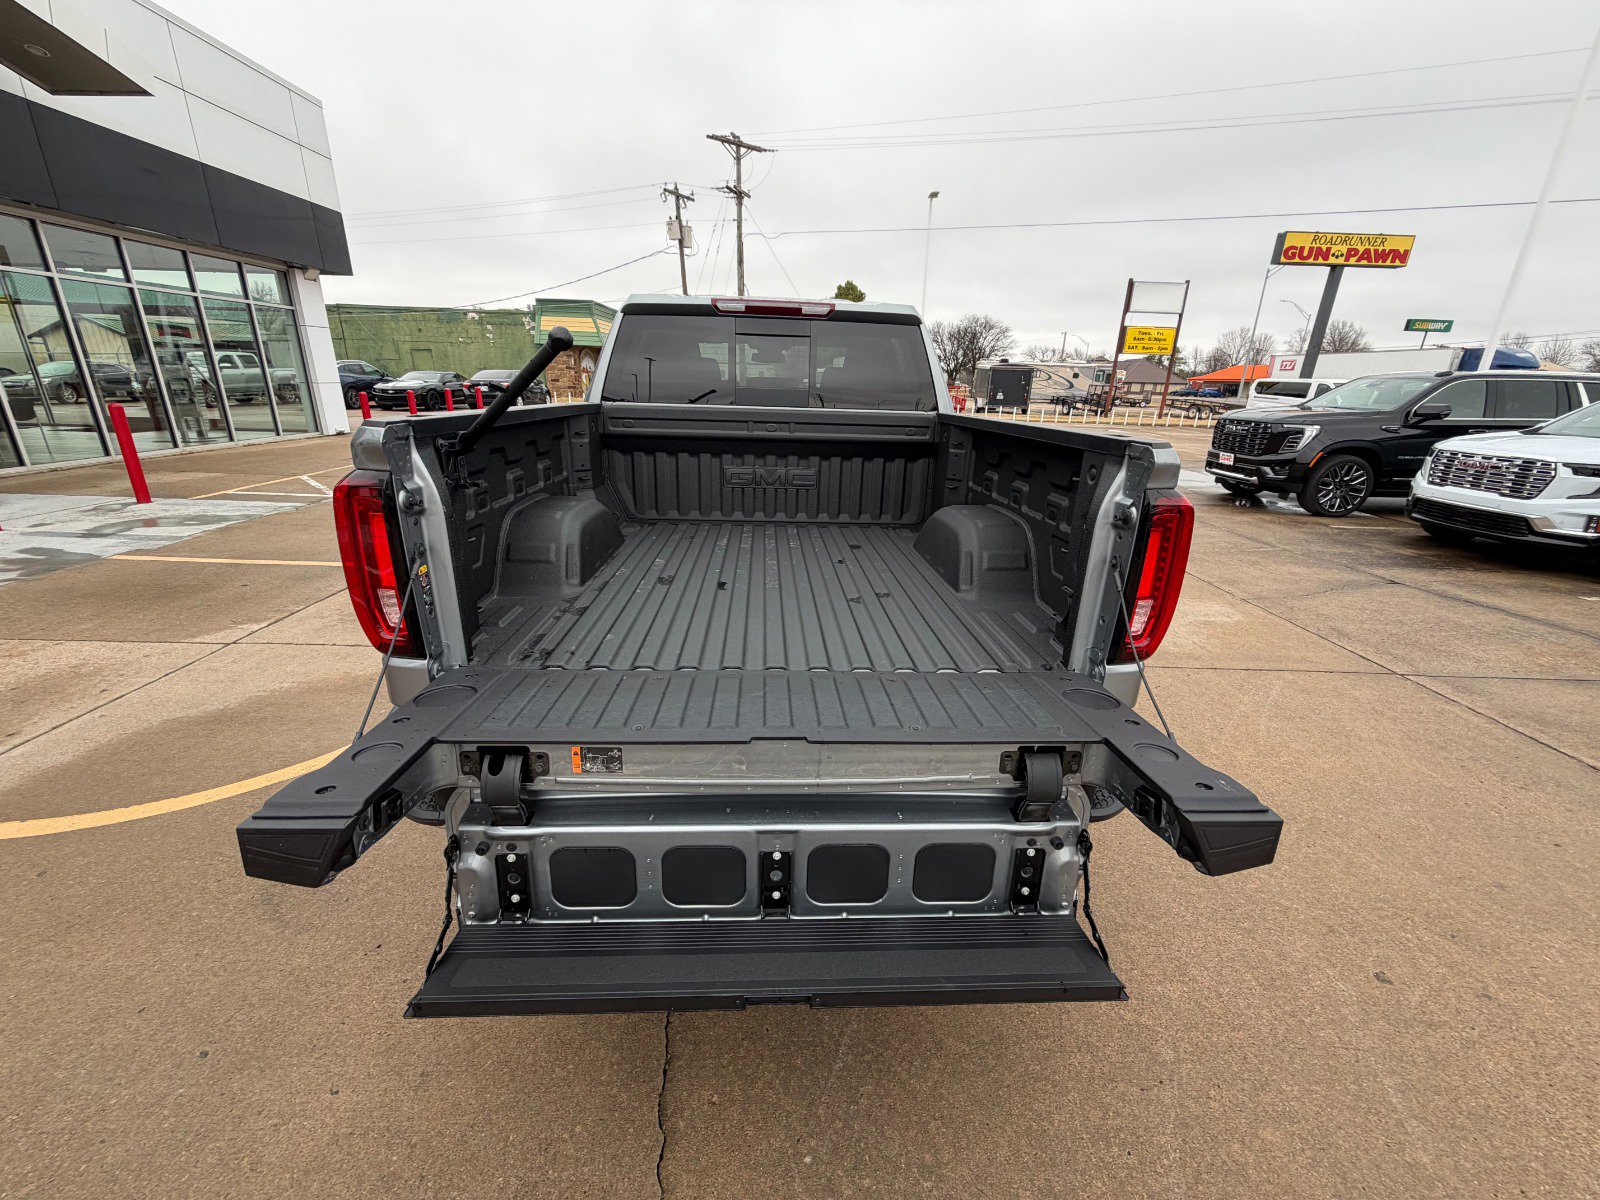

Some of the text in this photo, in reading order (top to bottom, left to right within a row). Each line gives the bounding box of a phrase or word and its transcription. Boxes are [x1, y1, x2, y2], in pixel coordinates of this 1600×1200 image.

[1310, 234, 1388, 248] ROADRUNNER
[1282, 245, 1410, 265] GUN PAWN
[1413, 321, 1450, 330] SUBWAY
[724, 467, 817, 489] GMC
